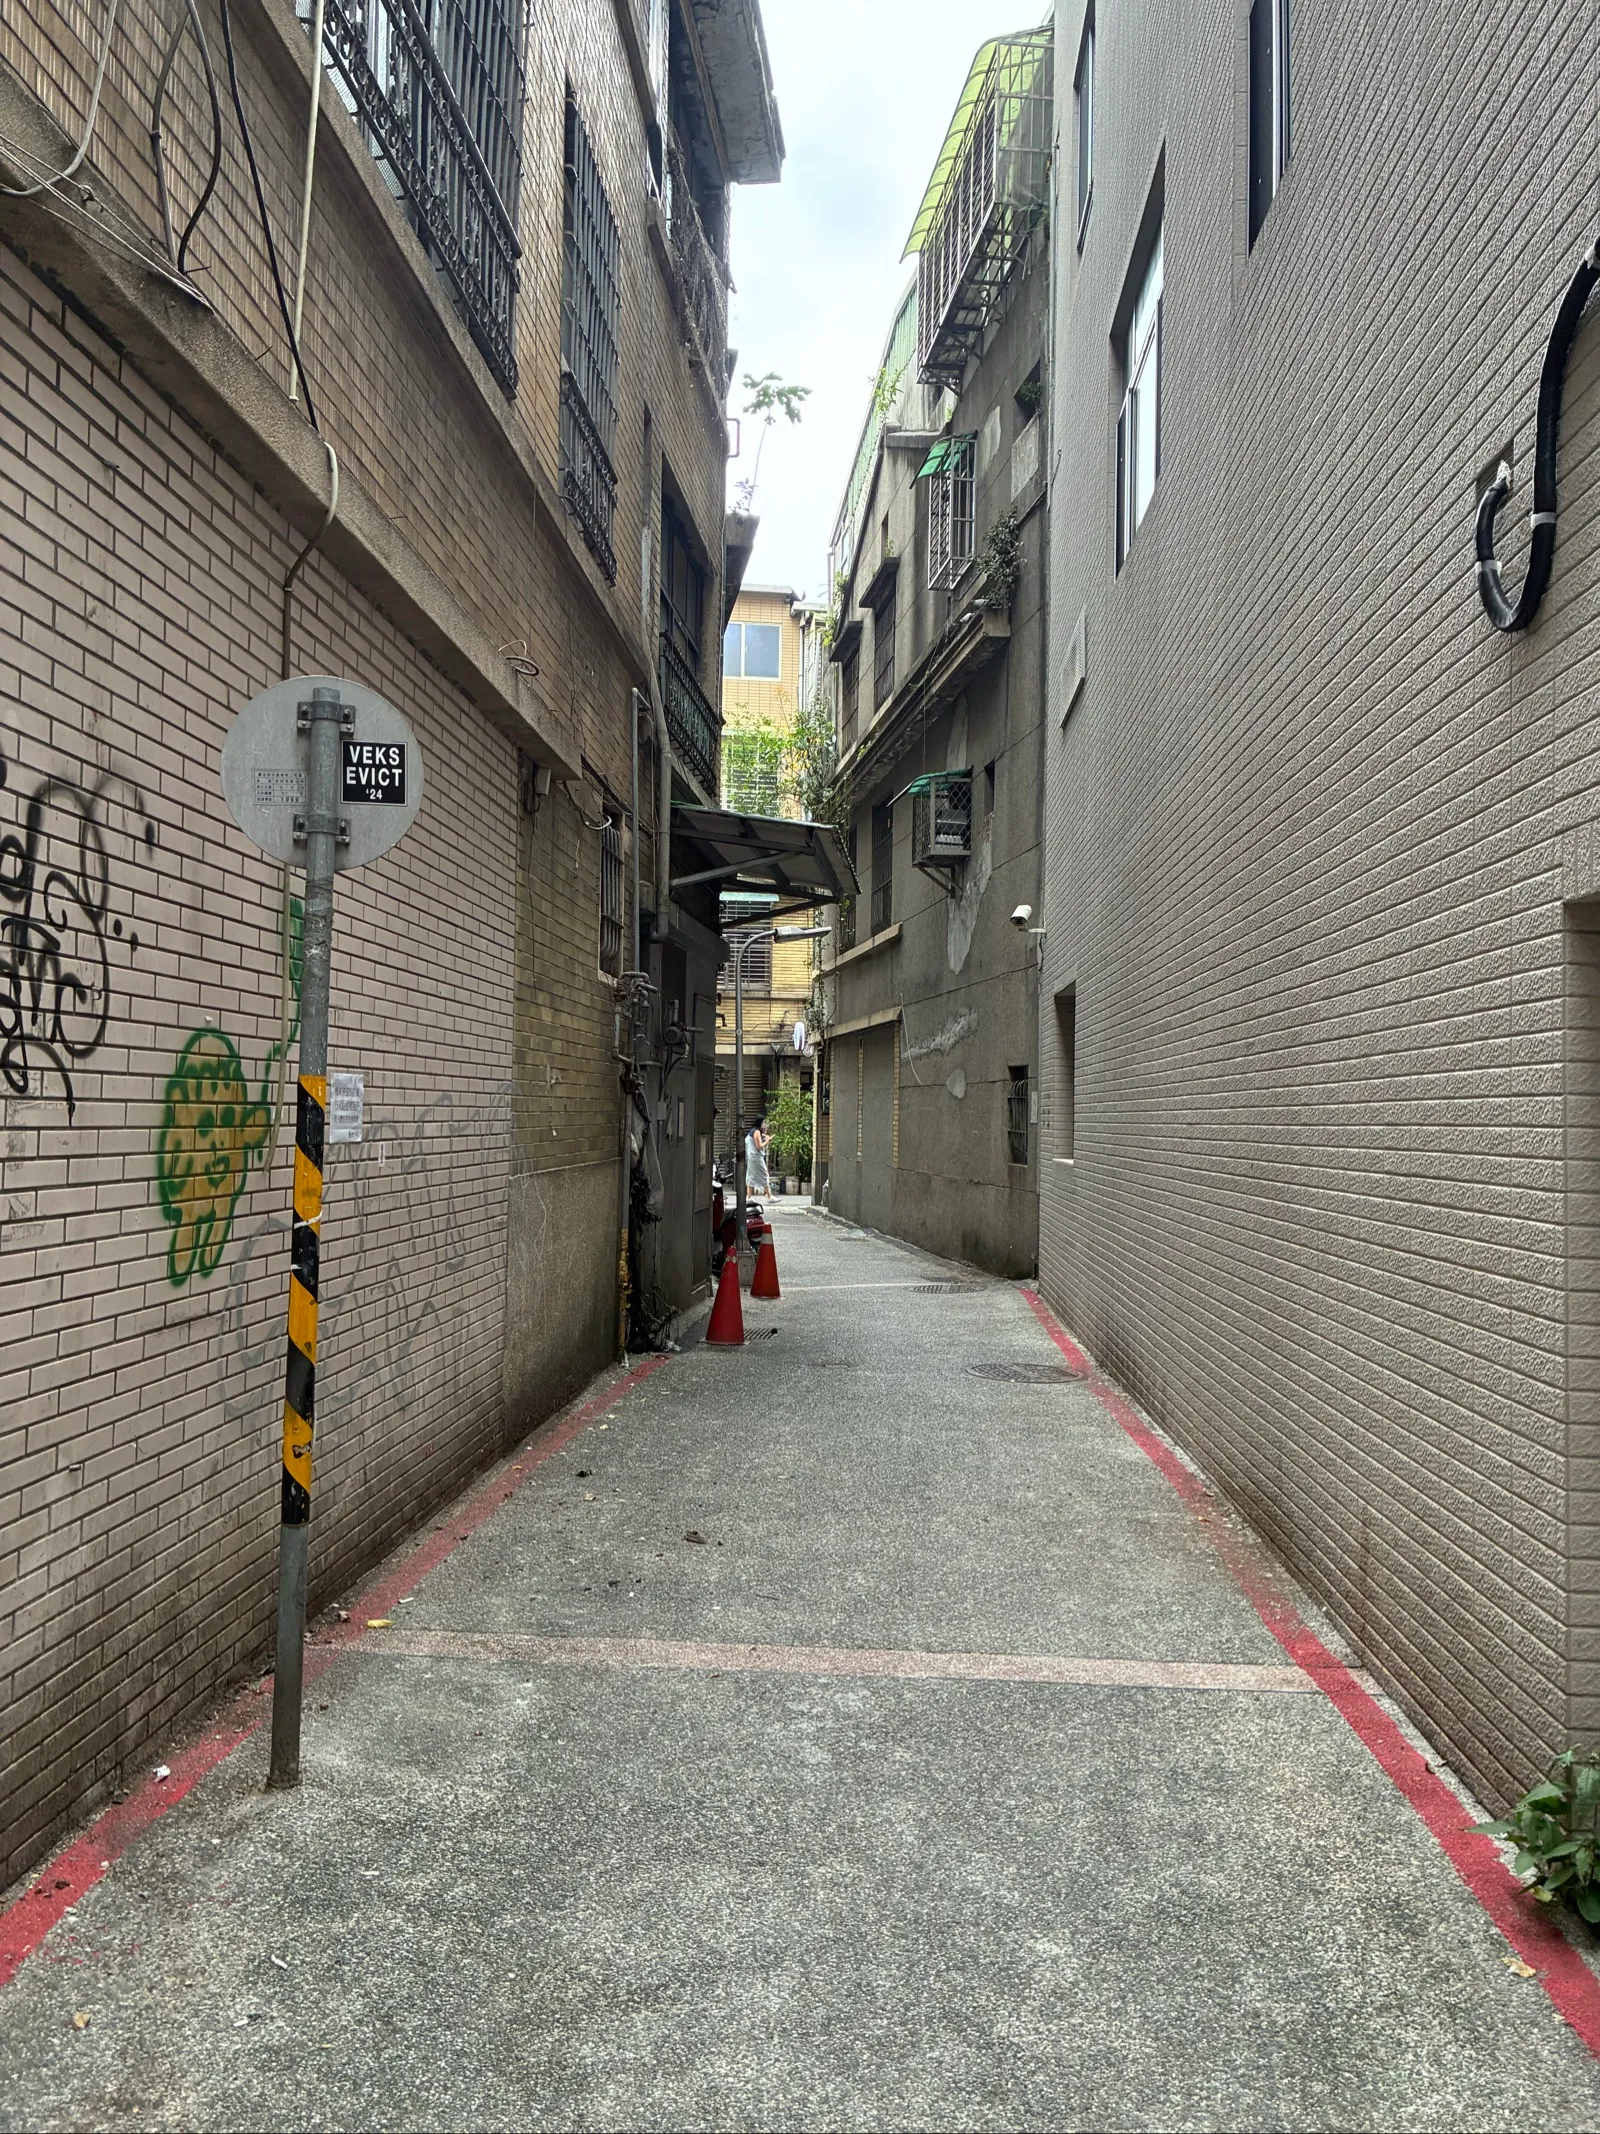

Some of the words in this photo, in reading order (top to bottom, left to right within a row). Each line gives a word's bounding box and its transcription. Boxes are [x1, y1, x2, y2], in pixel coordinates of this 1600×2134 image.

[349, 745, 400, 766] VEKS
[346, 766, 402, 787] EVICT
[366, 788, 383, 800] '24
